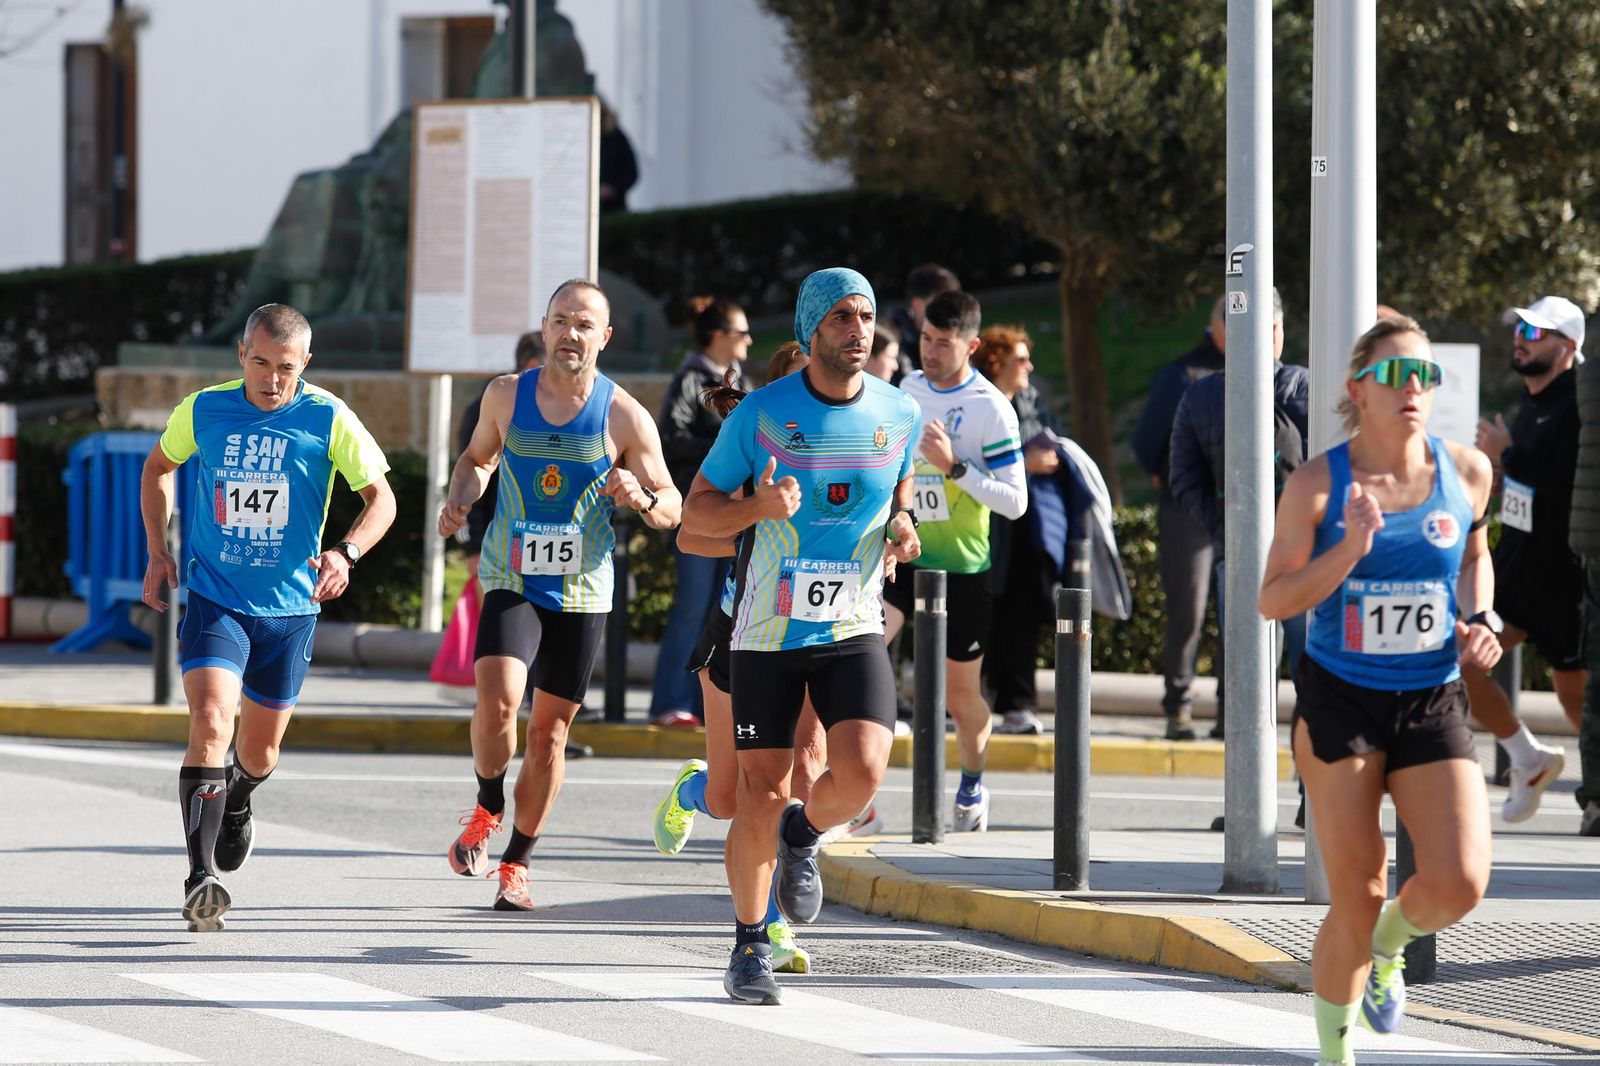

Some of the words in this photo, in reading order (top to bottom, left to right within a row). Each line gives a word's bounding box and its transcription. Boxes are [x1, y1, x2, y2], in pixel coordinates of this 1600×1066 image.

[1311, 160, 1326, 172] 75
[224, 434, 242, 469] ERA
[245, 434, 288, 459] SAN
[216, 470, 227, 478] III
[230, 471, 287, 480] CARRERA
[229, 488, 279, 513] 147
[915, 490, 938, 509] 10
[1505, 494, 1527, 518] 231
[515, 521, 527, 529] III
[529, 523, 580, 534] CARRERA
[526, 540, 573, 563] 115
[785, 559, 798, 568] III
[802, 561, 860, 570] CARRERA
[808, 581, 843, 607] 67
[1370, 582, 1445, 594] CARRERA
[1370, 603, 1434, 634] 176
